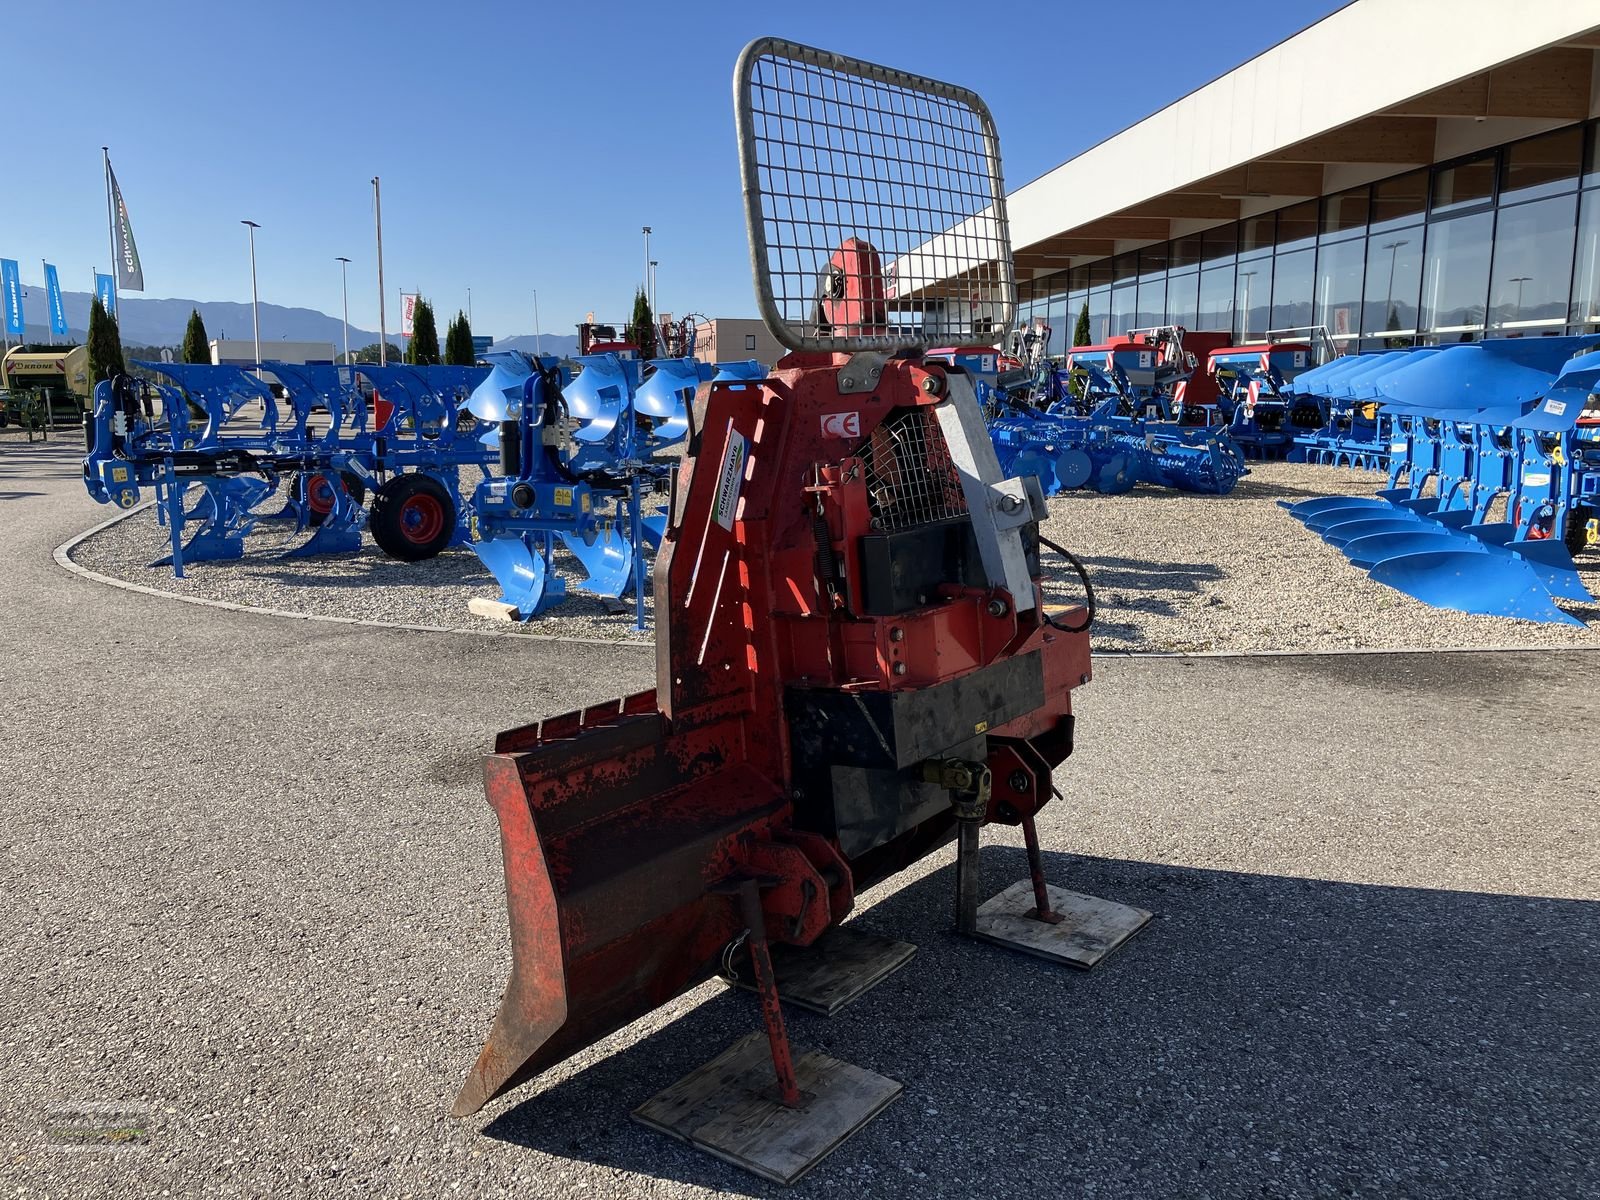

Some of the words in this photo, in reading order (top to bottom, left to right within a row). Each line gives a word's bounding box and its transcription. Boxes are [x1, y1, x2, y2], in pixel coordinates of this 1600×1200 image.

[823, 412, 858, 438] CE
[718, 445, 738, 517] SCHWARZMAYR
[723, 477, 736, 518] LANDTECHNIK
